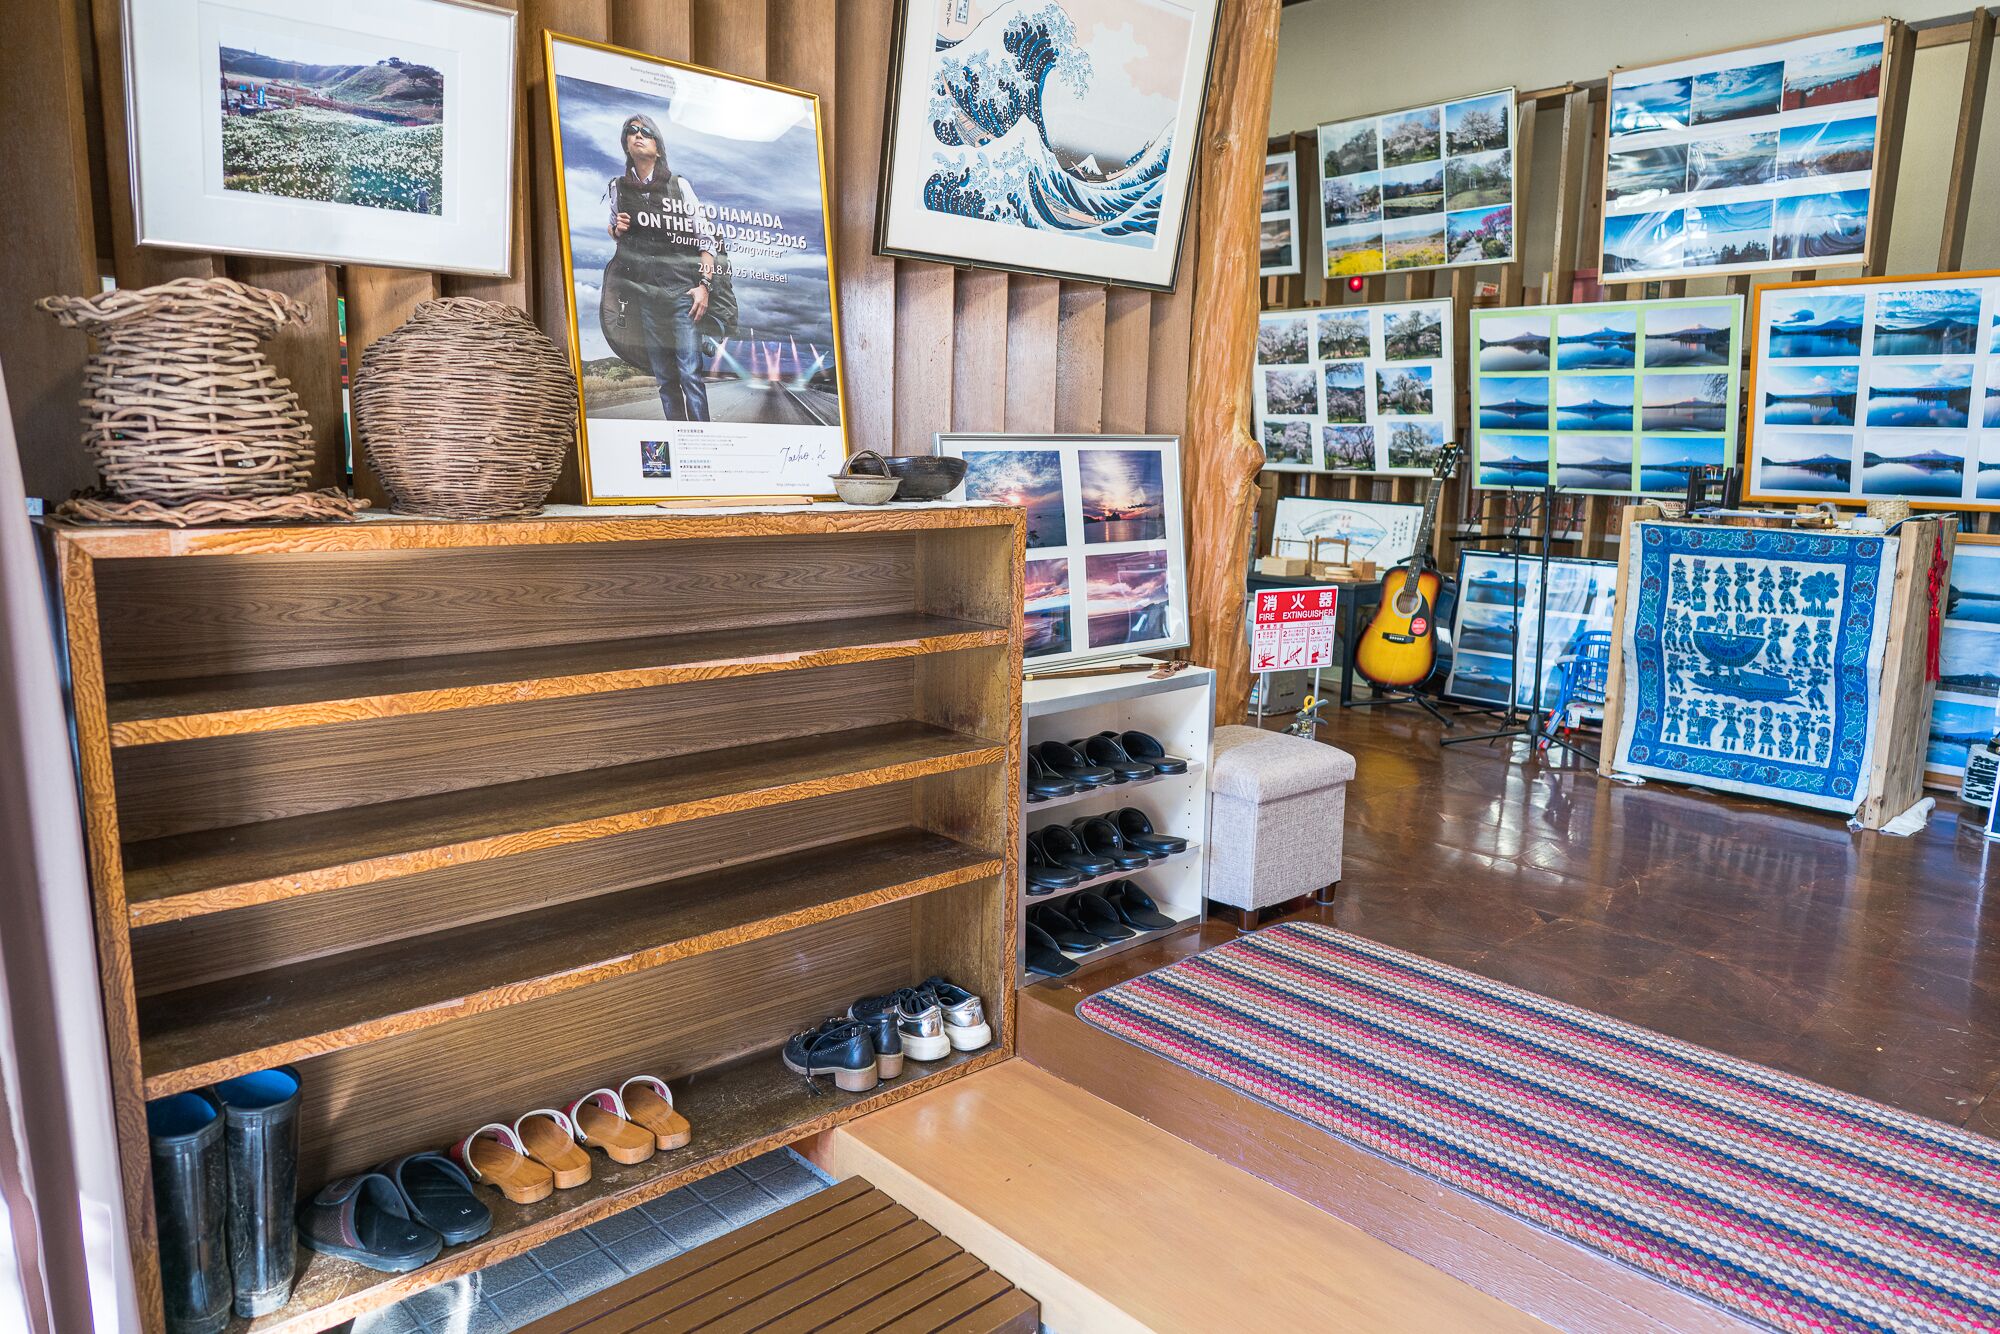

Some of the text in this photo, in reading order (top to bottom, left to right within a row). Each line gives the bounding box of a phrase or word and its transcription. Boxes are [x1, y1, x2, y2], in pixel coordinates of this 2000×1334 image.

[661, 197, 784, 230] SHOGO HAMADA
[637, 212, 807, 250] ON THE ROAD 2015-2016
[713, 239, 724, 251] of
[724, 243, 731, 251] a
[697, 262, 789, 283] 2018.4.25 Release!
[1262, 591, 1333, 612] 消火器
[1258, 608, 1334, 621] FIRE EXTINGUISHER
